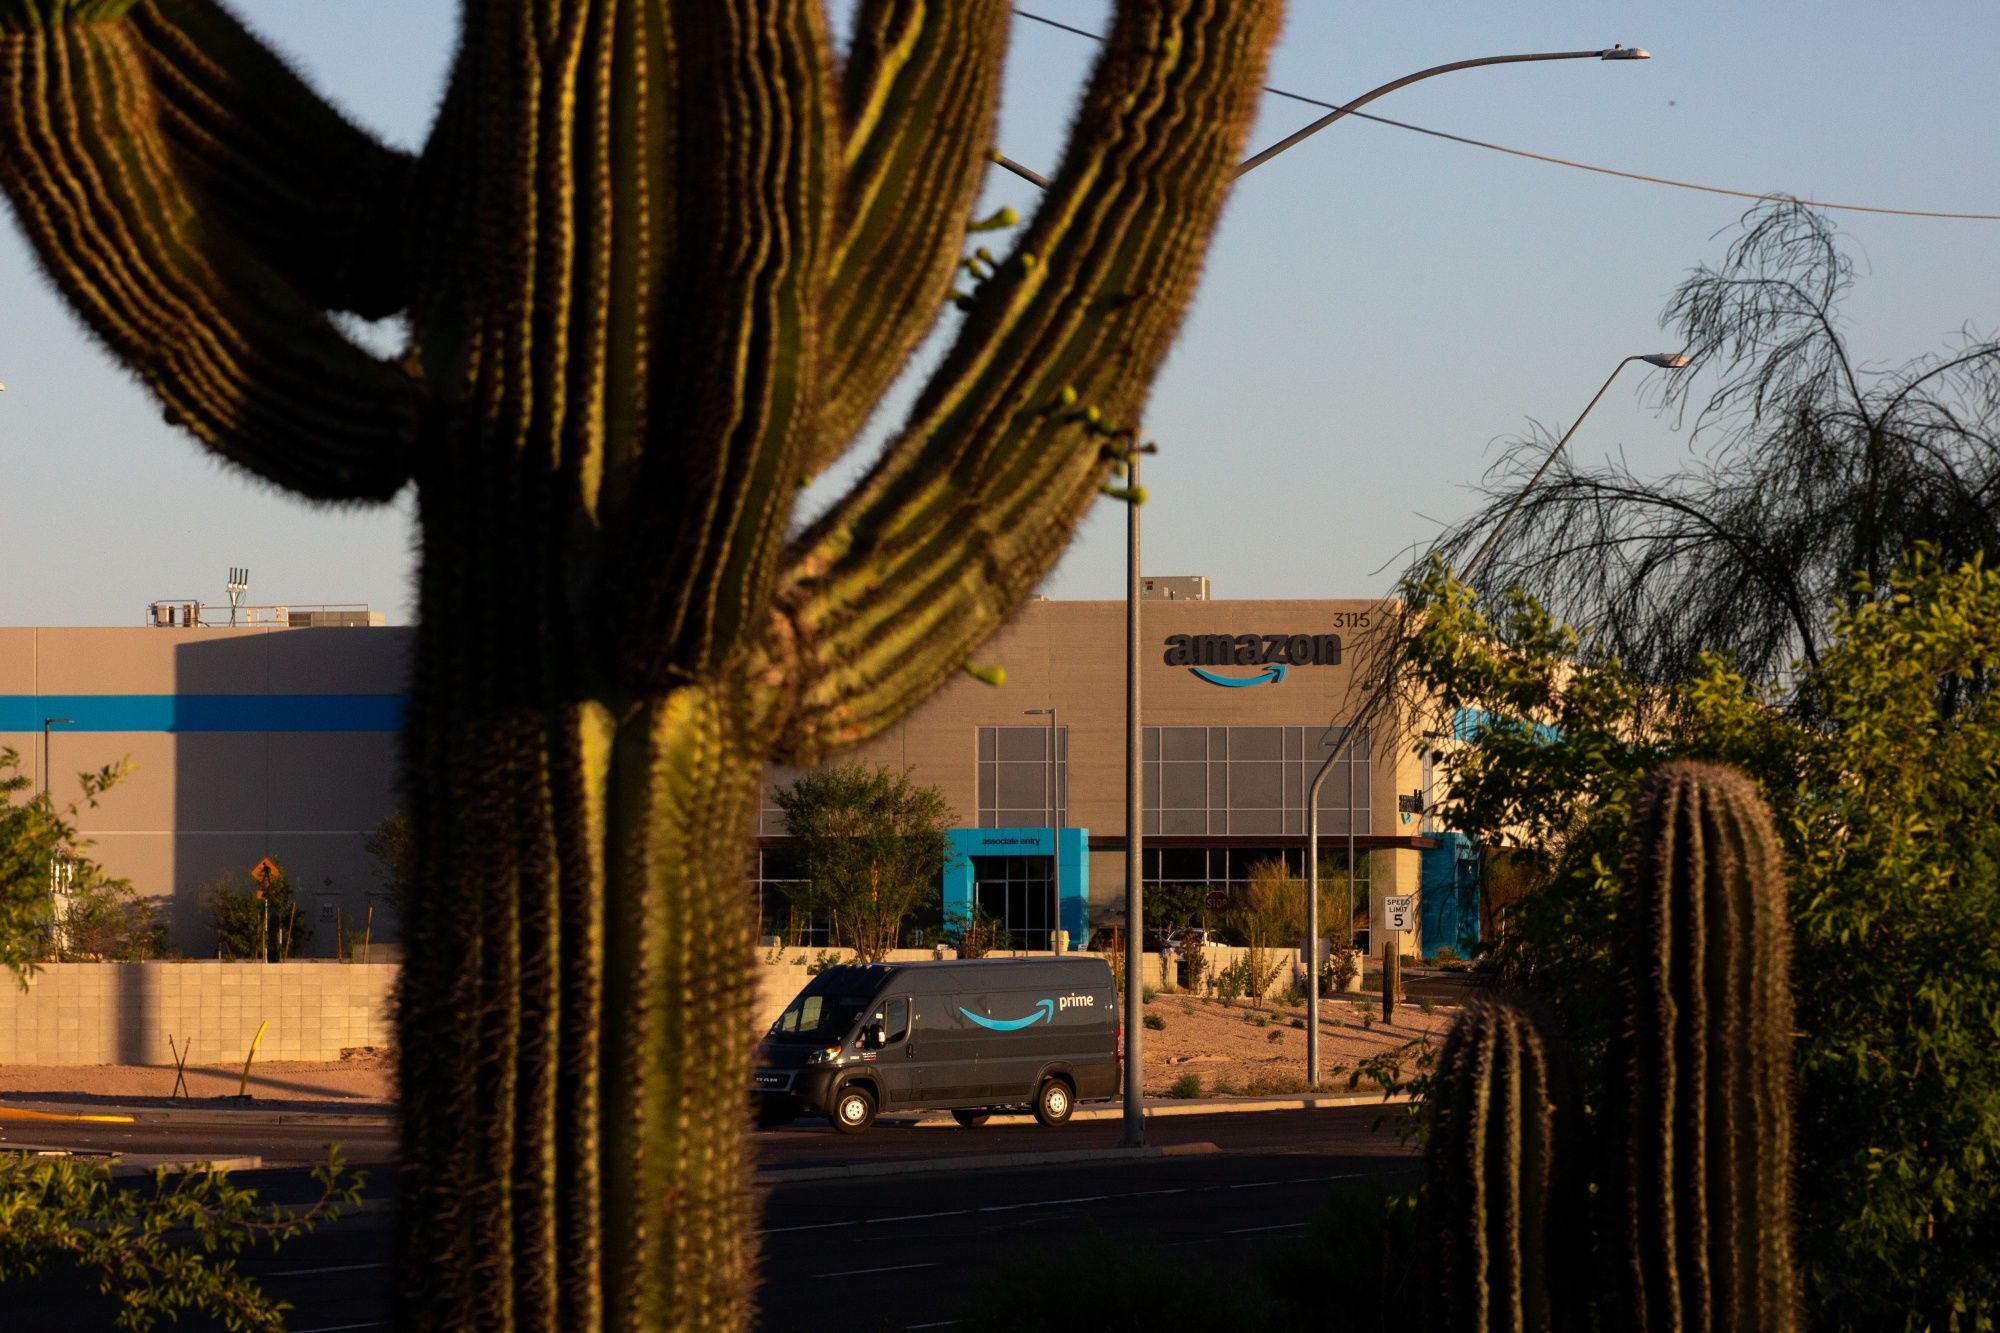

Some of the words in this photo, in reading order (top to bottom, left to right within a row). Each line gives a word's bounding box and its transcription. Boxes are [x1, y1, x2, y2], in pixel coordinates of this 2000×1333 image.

[1333, 612, 1370, 628] 3115
[1163, 633, 1342, 666] amazon
[1206, 898, 1228, 908] STOP
[1387, 898, 1411, 906] SPEED
[1394, 914, 1404, 927] 5
[1059, 992, 1094, 1011] prime
